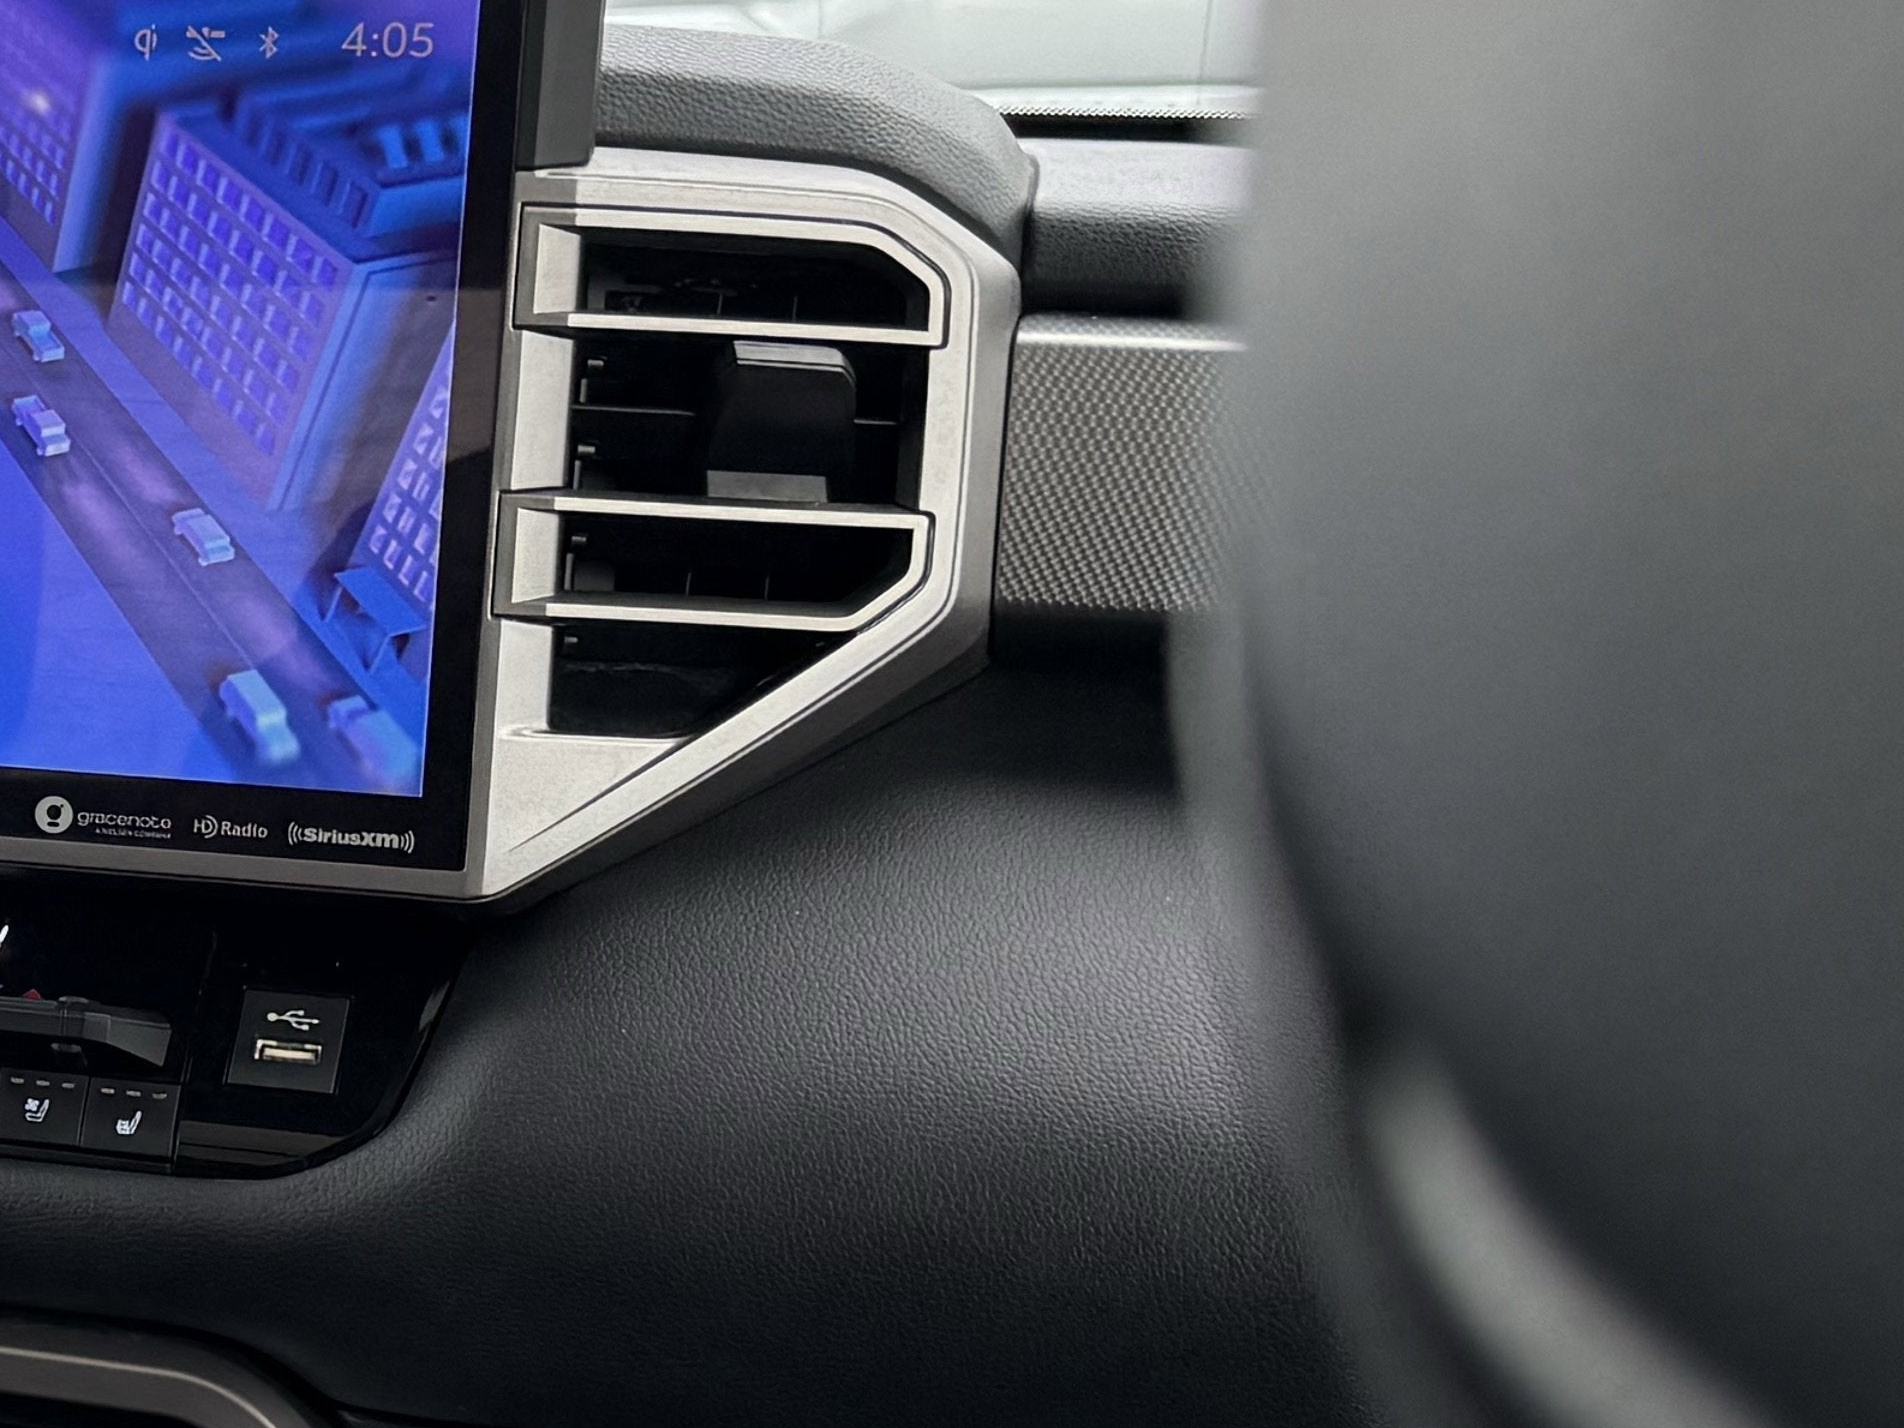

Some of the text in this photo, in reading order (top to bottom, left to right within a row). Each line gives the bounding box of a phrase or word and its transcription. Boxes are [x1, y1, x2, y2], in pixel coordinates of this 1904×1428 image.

[341, 21, 436, 59] 4:05
[76, 811, 173, 830] gracenote
[220, 821, 269, 839] Radio
